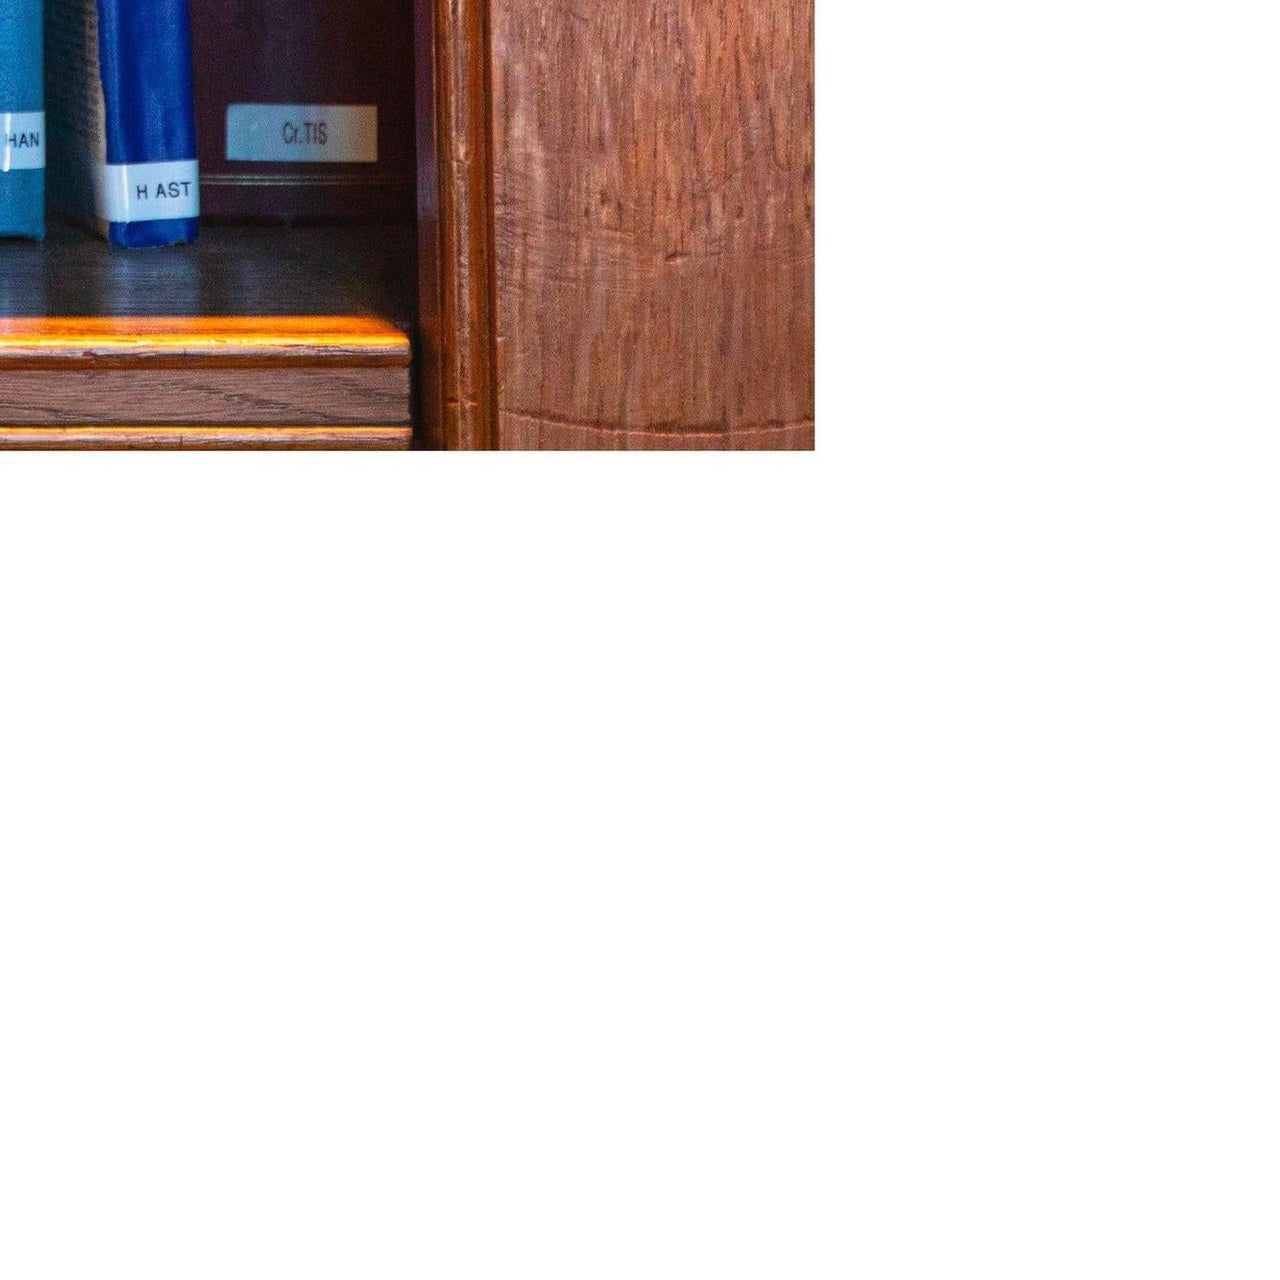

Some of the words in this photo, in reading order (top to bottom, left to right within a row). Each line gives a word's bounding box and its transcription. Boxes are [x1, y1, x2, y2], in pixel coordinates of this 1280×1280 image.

[6, 131, 40, 149] HAN
[136, 185, 149, 200] H
[155, 181, 192, 199] AST
